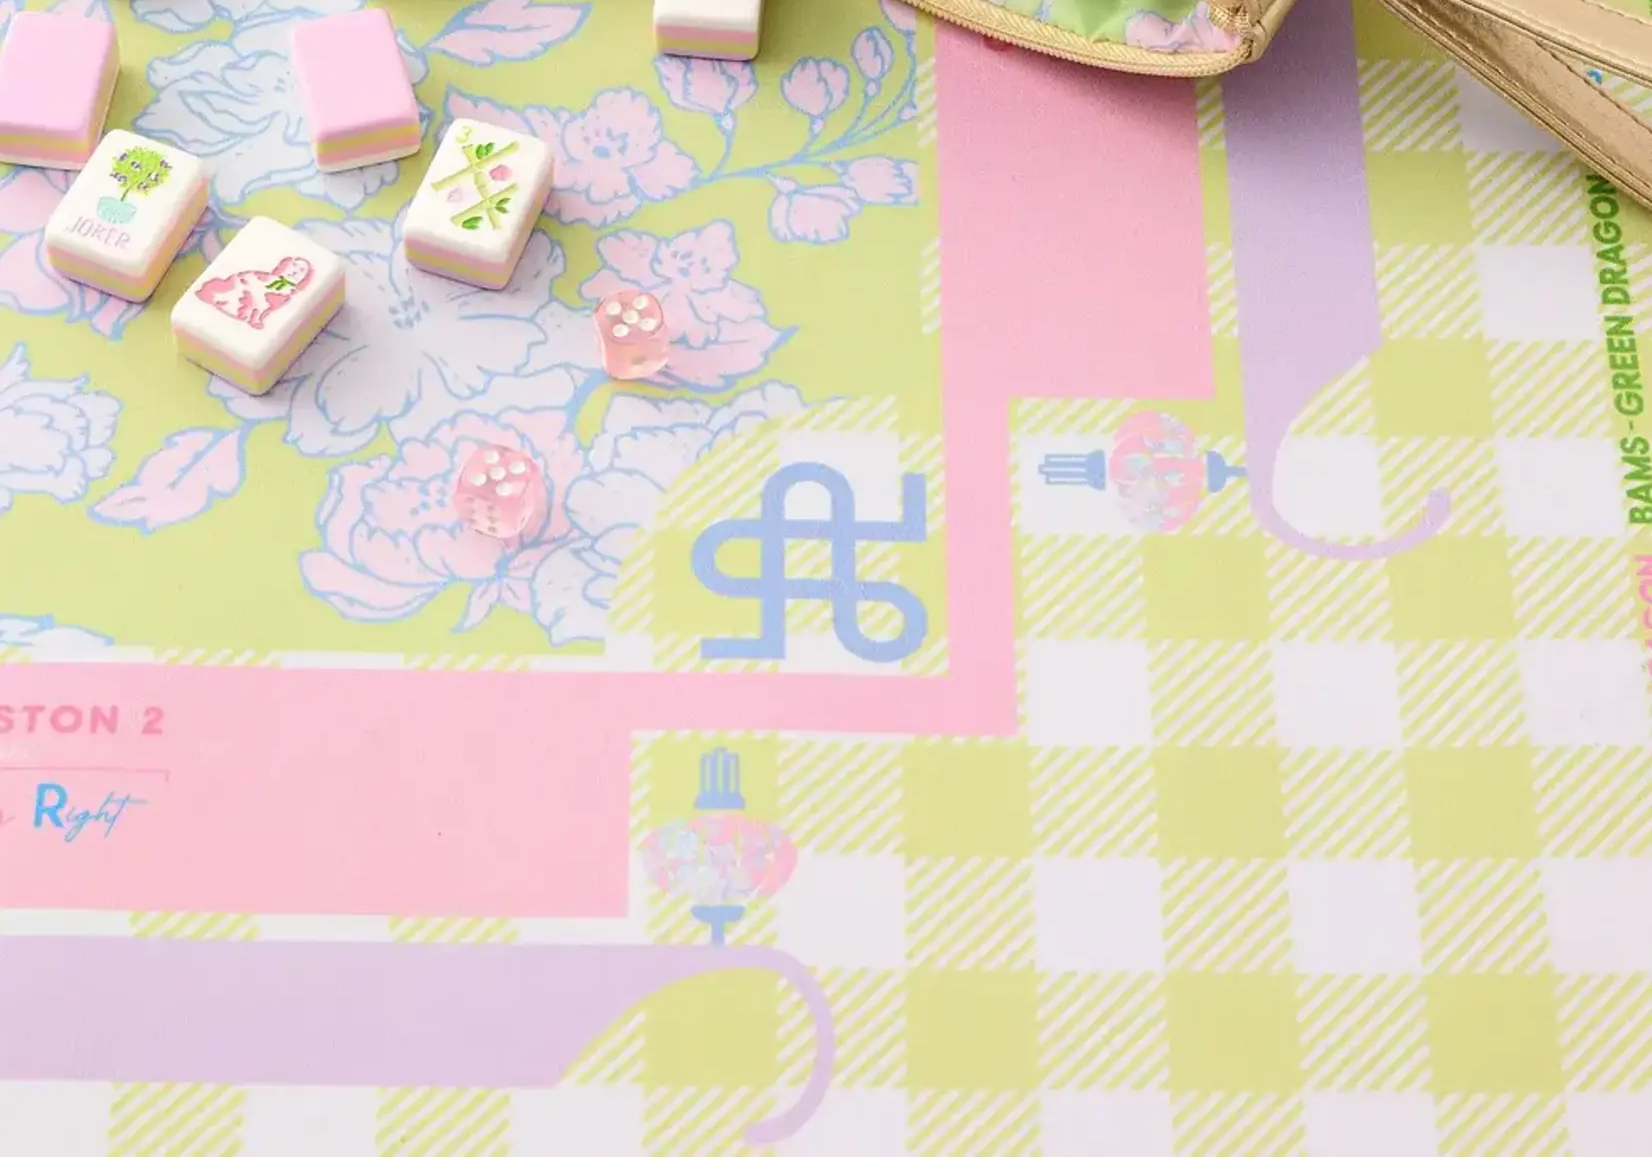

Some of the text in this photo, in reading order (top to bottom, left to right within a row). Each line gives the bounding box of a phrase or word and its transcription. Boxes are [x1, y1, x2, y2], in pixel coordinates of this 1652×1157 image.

[65, 216, 132, 250] JOKER
[1603, 315, 1644, 417] GREEN
[1620, 436, 1652, 524] BAMS
[141, 706, 165, 735] 2
[33, 781, 150, 843] Right
